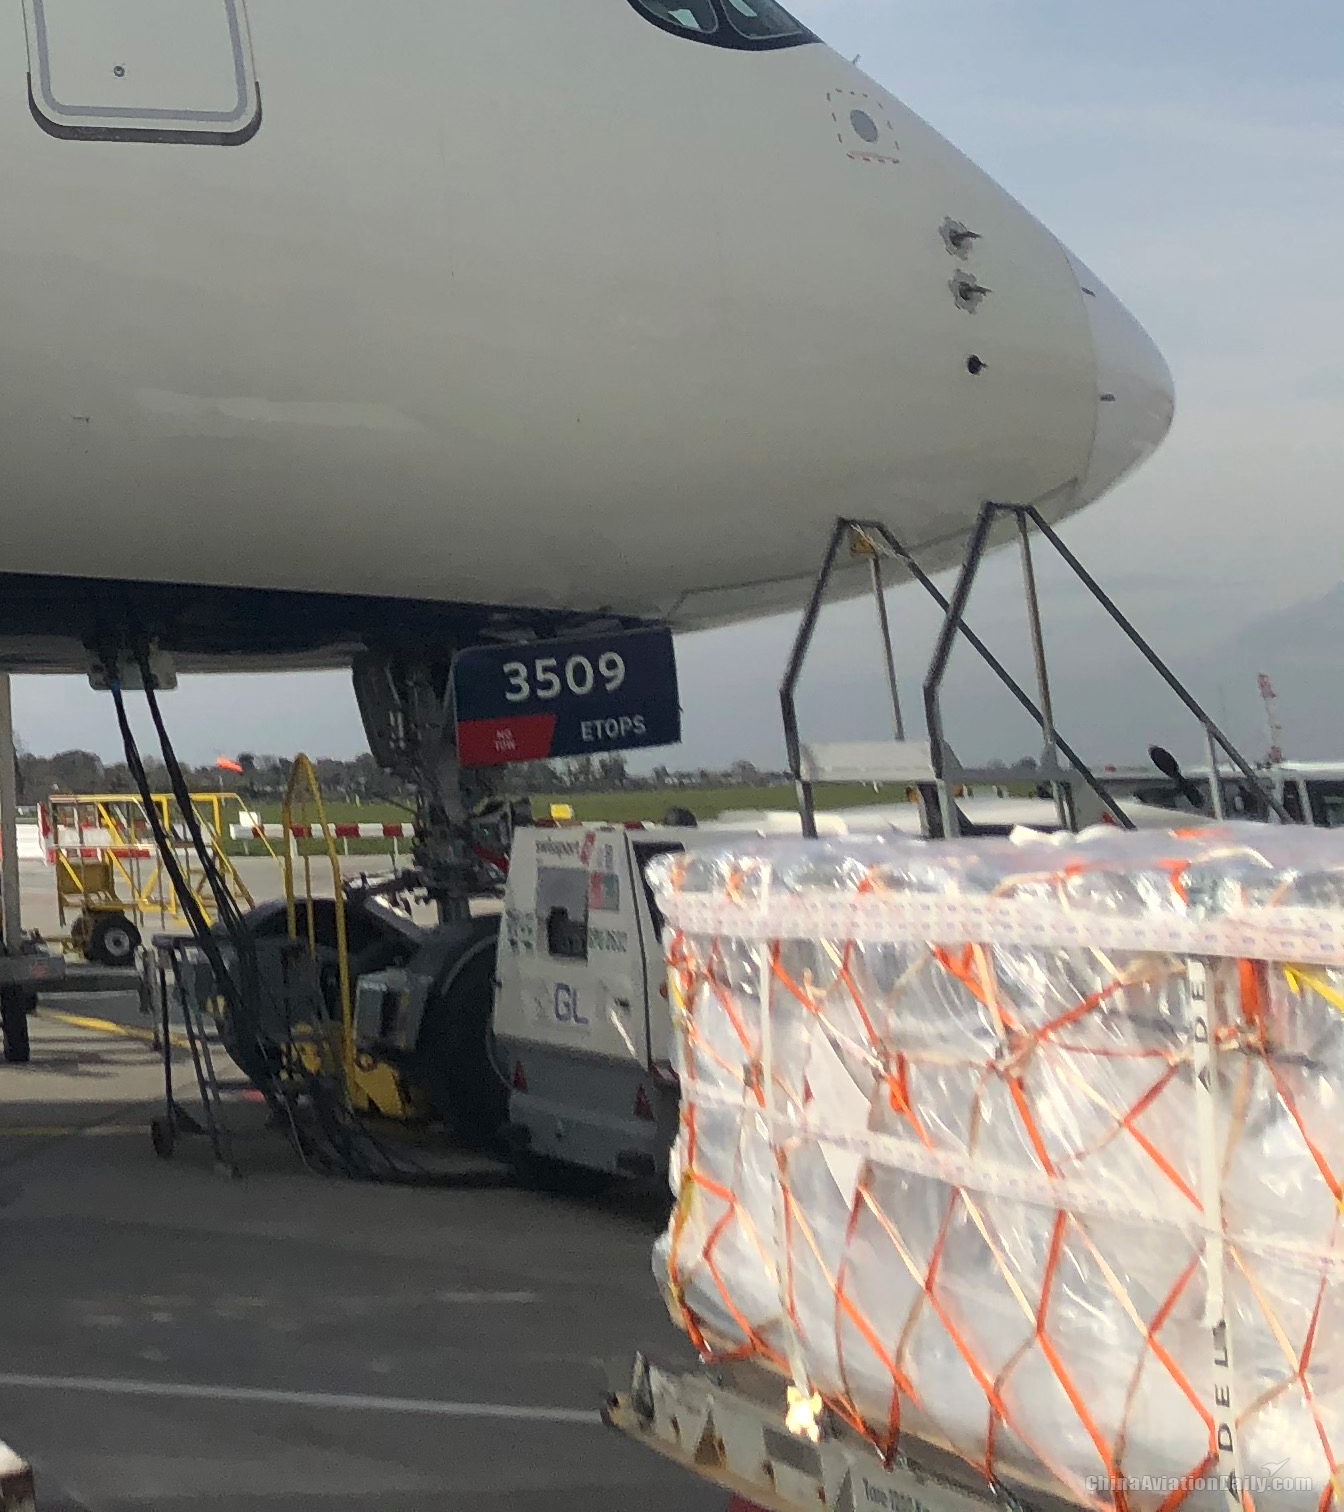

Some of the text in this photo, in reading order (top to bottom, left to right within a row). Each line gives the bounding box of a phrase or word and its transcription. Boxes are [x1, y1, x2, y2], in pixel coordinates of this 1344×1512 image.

[502, 651, 626, 702] 3509
[580, 714, 646, 742] ETOPS
[554, 982, 589, 1024] GL
